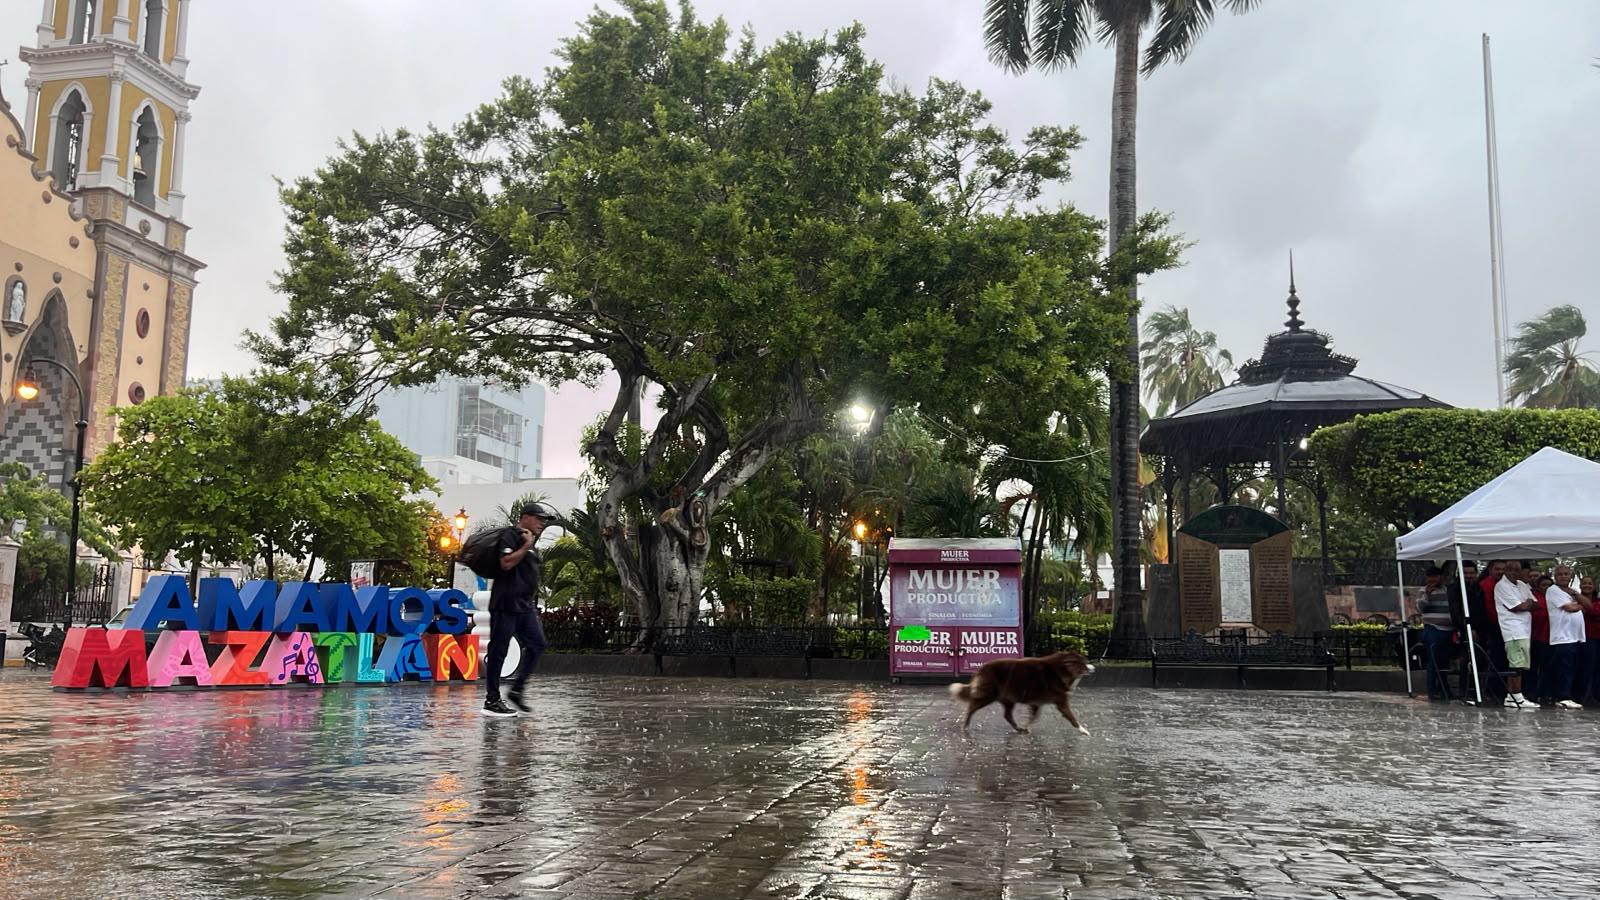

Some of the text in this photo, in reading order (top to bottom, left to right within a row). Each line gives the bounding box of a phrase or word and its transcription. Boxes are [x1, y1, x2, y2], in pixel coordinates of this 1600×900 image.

[941, 550, 969, 558] MUJER
[907, 569, 1002, 593] MUJER
[123, 575, 468, 635] AMAMOS
[908, 592, 1003, 605] PRODUCTIVA
[961, 631, 1018, 647] MUJER
